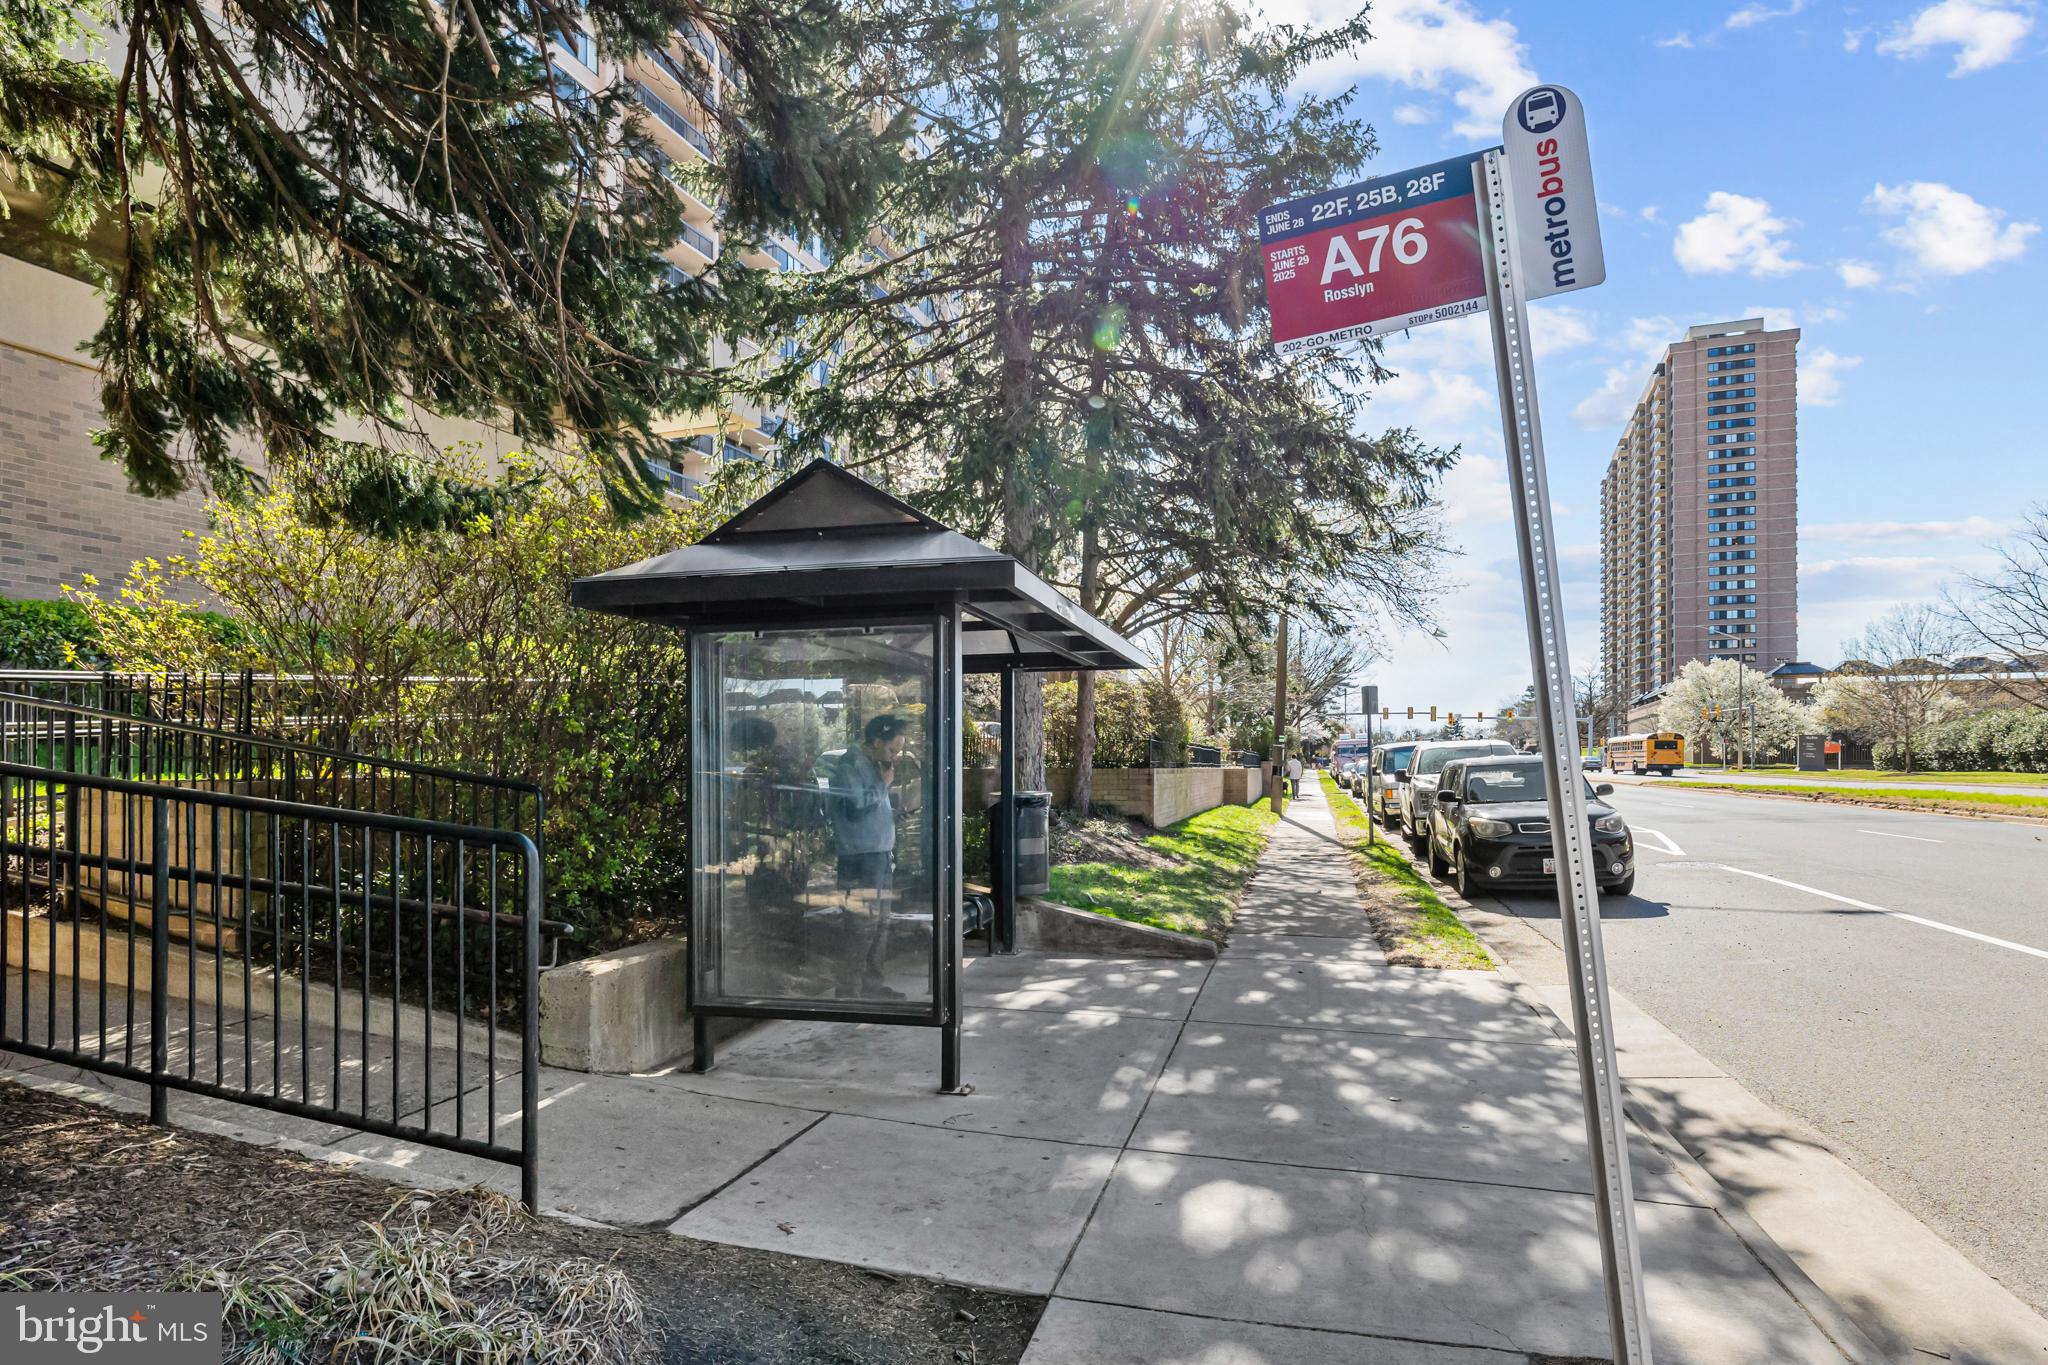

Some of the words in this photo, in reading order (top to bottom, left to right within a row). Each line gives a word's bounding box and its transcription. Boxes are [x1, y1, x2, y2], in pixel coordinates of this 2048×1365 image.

[1312, 197, 1352, 222] 22F,
[1356, 185, 1402, 211] 25B,
[1406, 172, 1445, 197] 28F
[1265, 210, 1290, 225] ENDS
[1537, 138, 1576, 287] metrobus
[1267, 220, 1290, 235] JUNE
[1292, 217, 1305, 229] 28
[1270, 245, 1305, 262] STARTS
[1320, 217, 1428, 285] A76
[1272, 258, 1295, 272] JUNE
[1297, 255, 1310, 267] 29
[1273, 269, 1296, 283] 2025
[1324, 282, 1374, 302] Rosslyn
[1408, 313, 1433, 325] STOP#
[1435, 301, 1478, 319] 5002144
[1282, 325, 1373, 353] 202-GO-METRO
